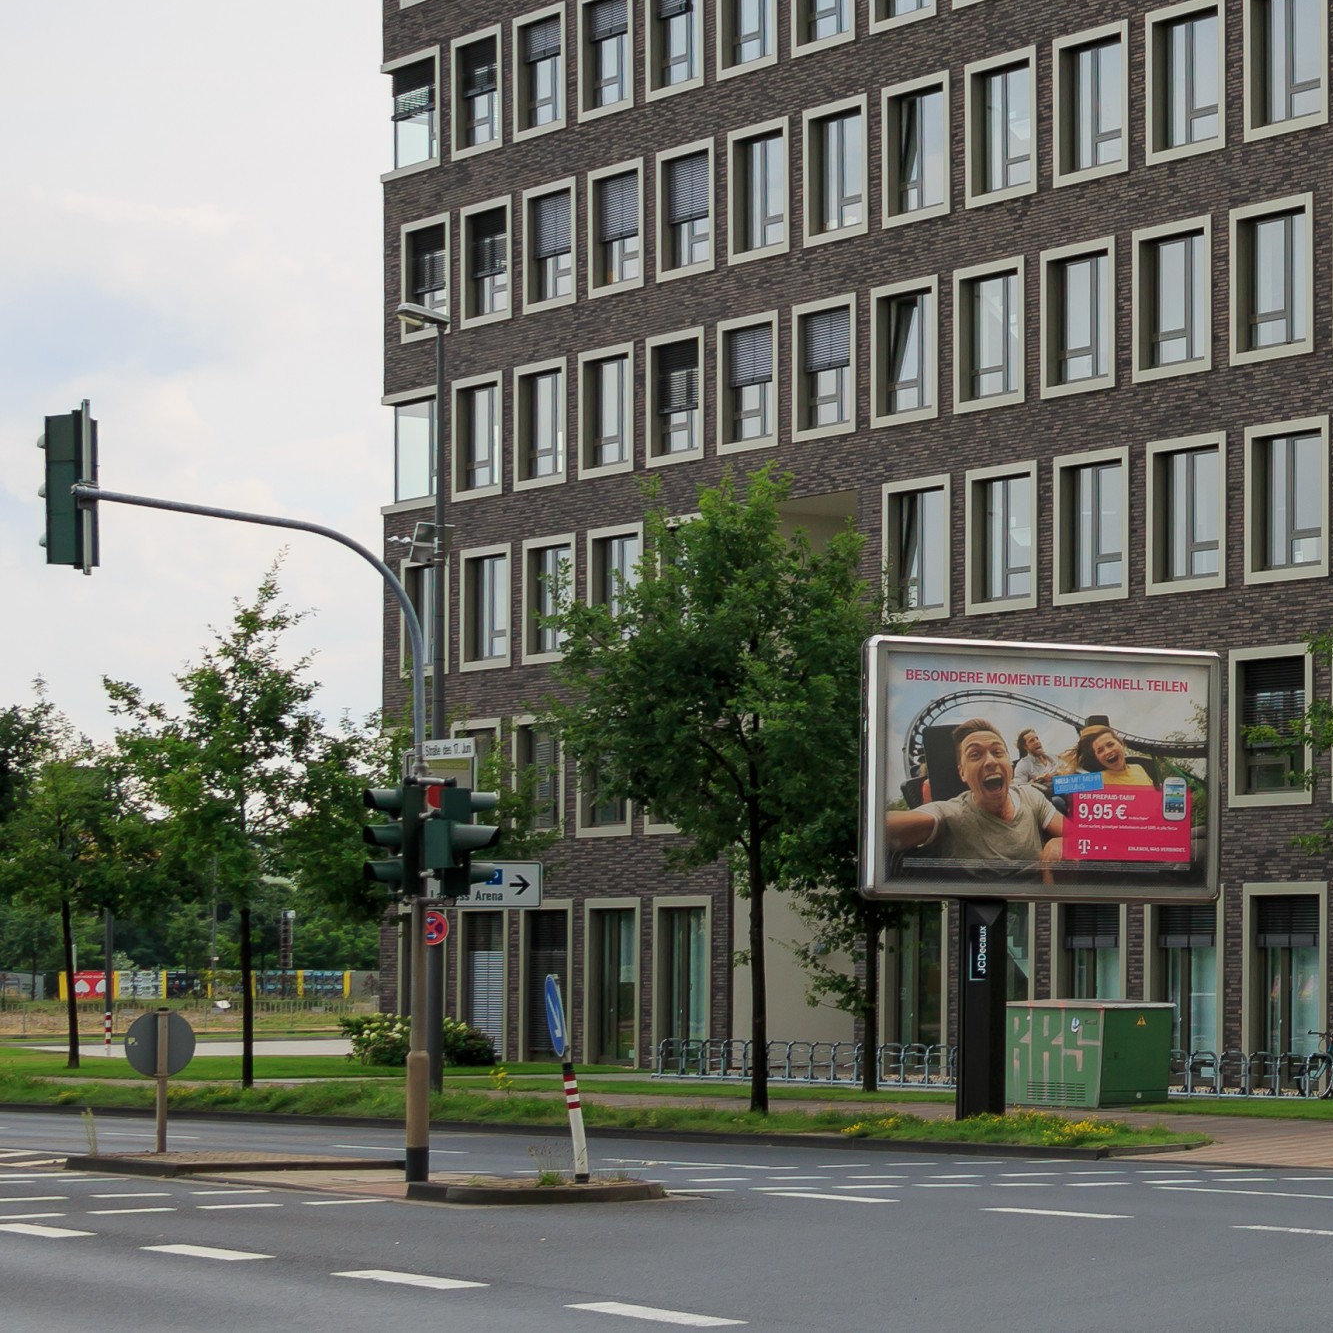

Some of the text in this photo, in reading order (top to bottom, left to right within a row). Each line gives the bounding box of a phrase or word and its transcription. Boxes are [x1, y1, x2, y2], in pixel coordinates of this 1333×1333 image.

[905, 669, 1188, 693] BESONDERE MOMENTE BLITZSCHNELL TEILEN
[425, 745, 441, 756] Straße
[443, 744, 452, 755] des
[462, 742, 471, 754] Juni
[1078, 803, 1128, 822] 9,95 €
[475, 890, 503, 901] Arena
[977, 925, 987, 975] JCDecaux
